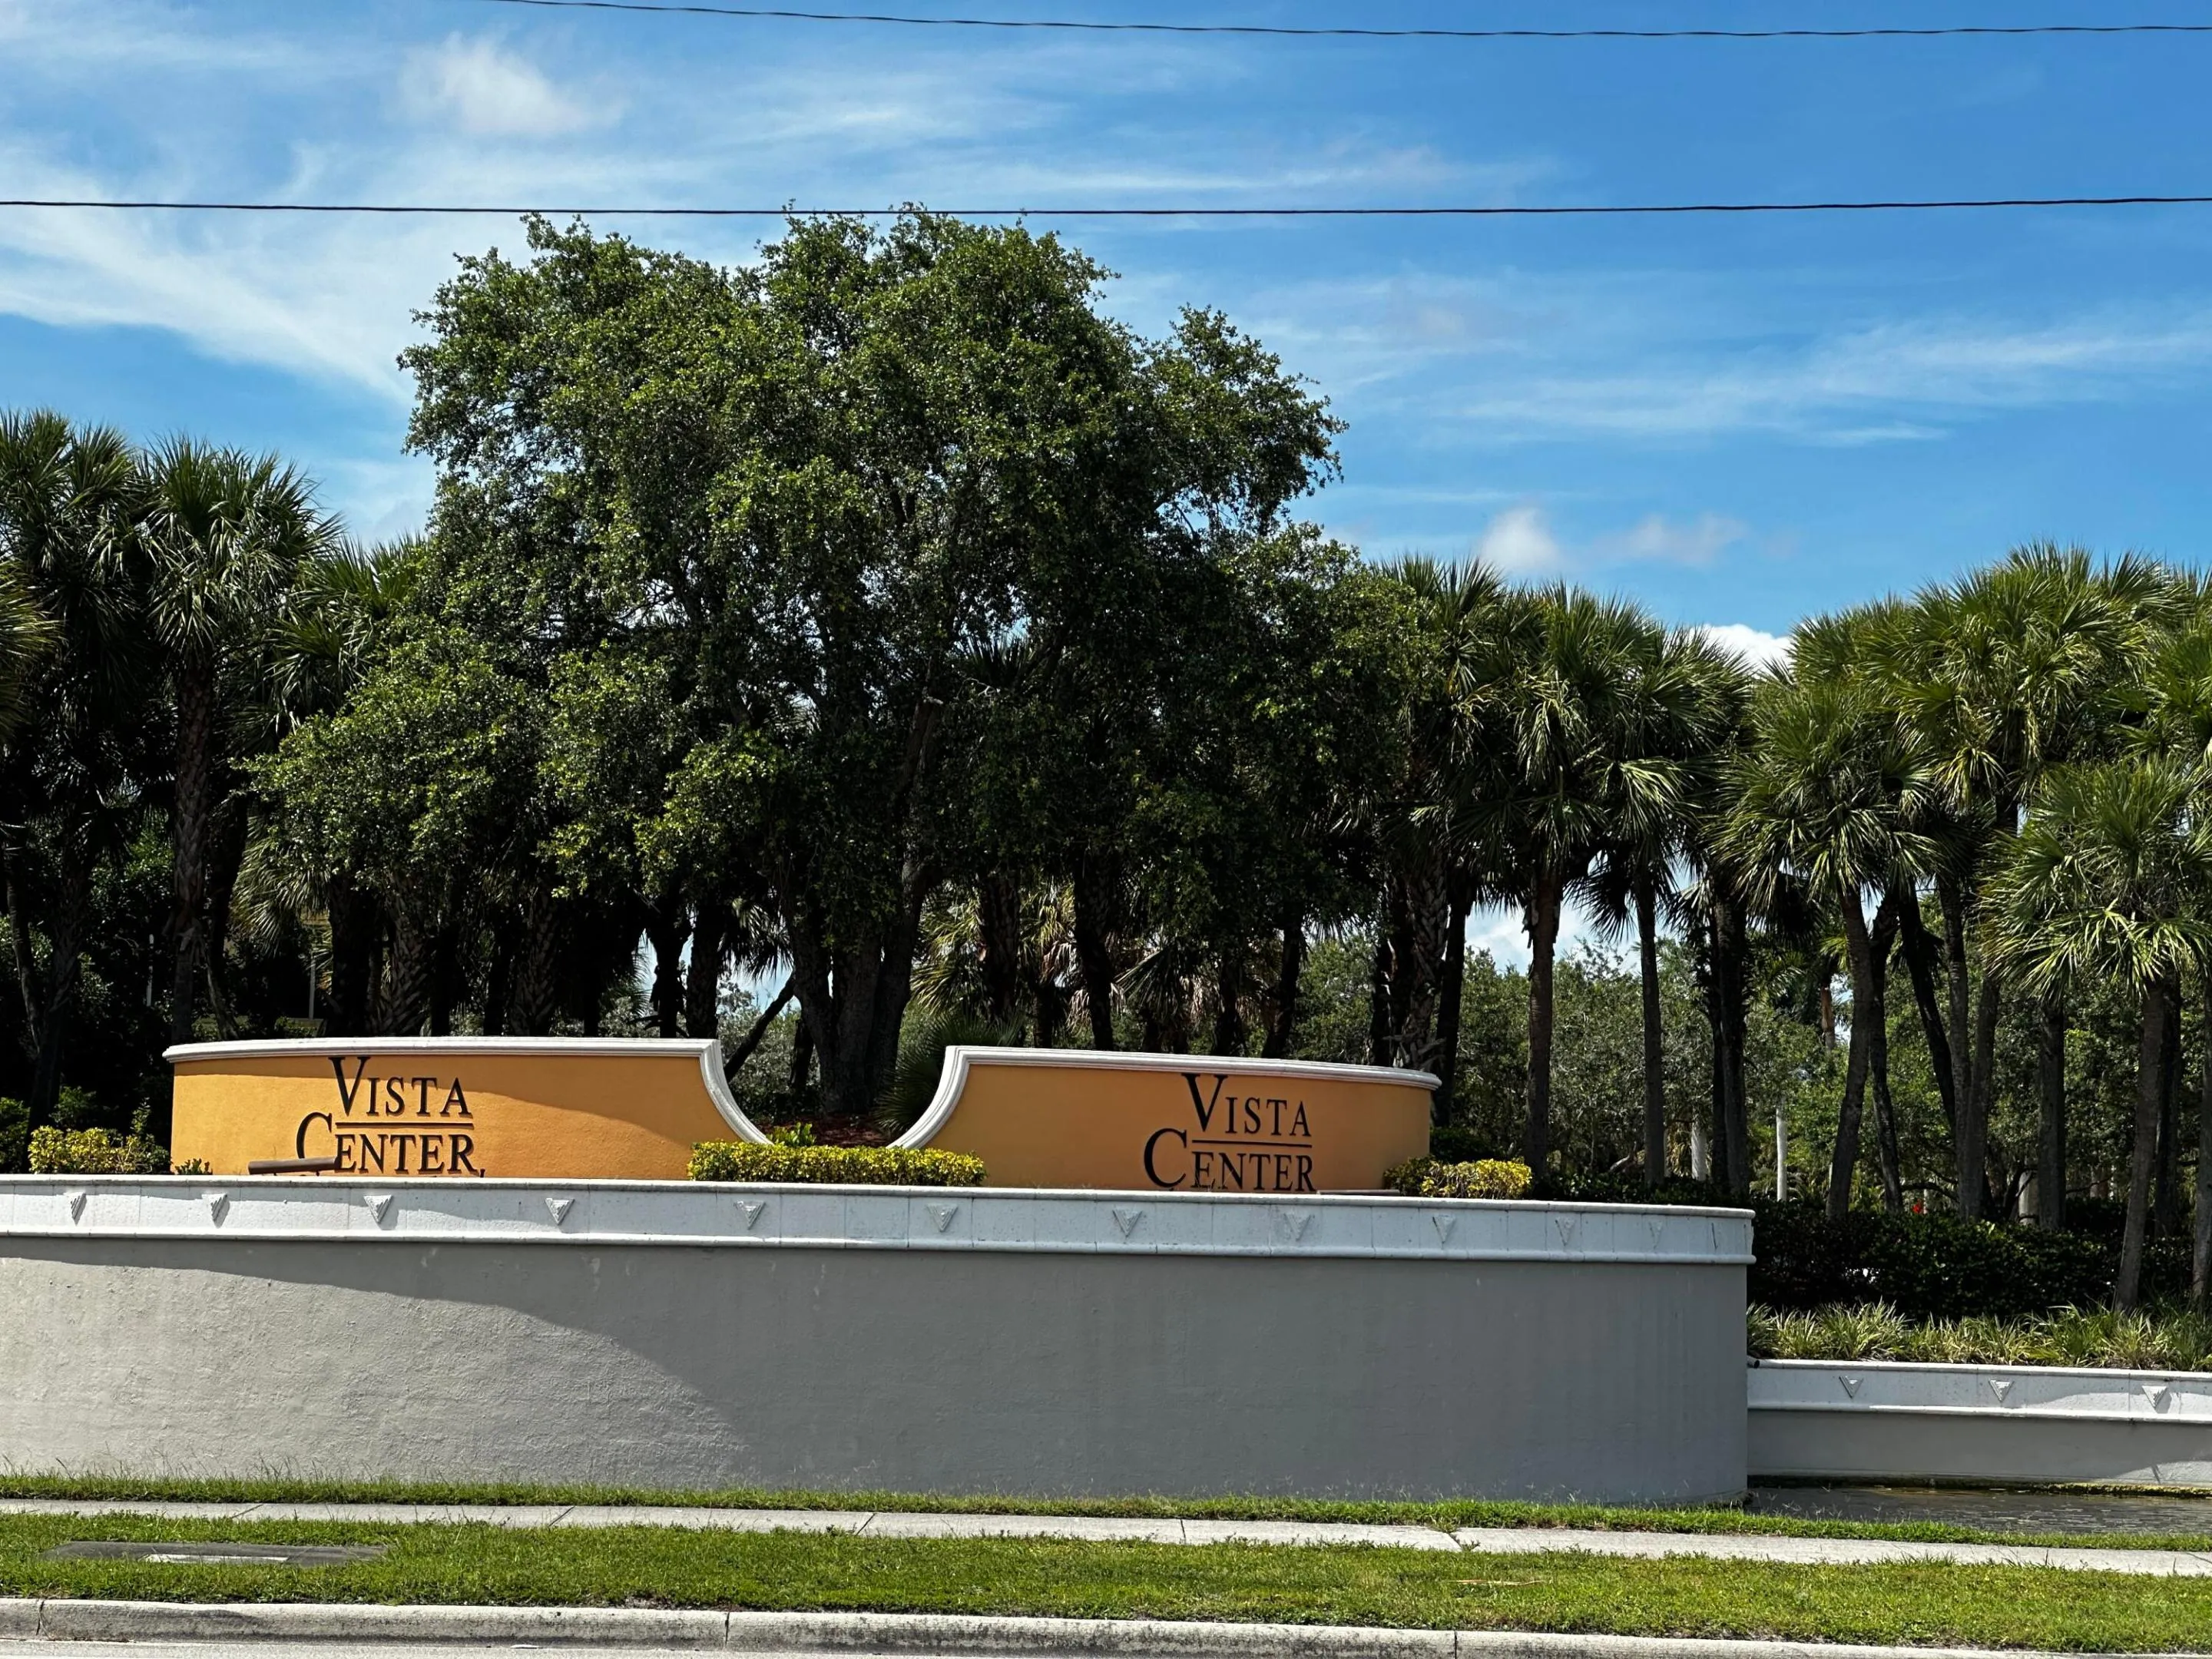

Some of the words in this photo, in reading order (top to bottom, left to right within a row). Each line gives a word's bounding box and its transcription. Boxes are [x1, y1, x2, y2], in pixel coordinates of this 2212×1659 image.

[328, 1055, 472, 1116] VISTA
[1181, 1073, 1312, 1137] VISTA
[296, 1111, 478, 1174] CENTER
[1144, 1128, 1317, 1192] CENTER
